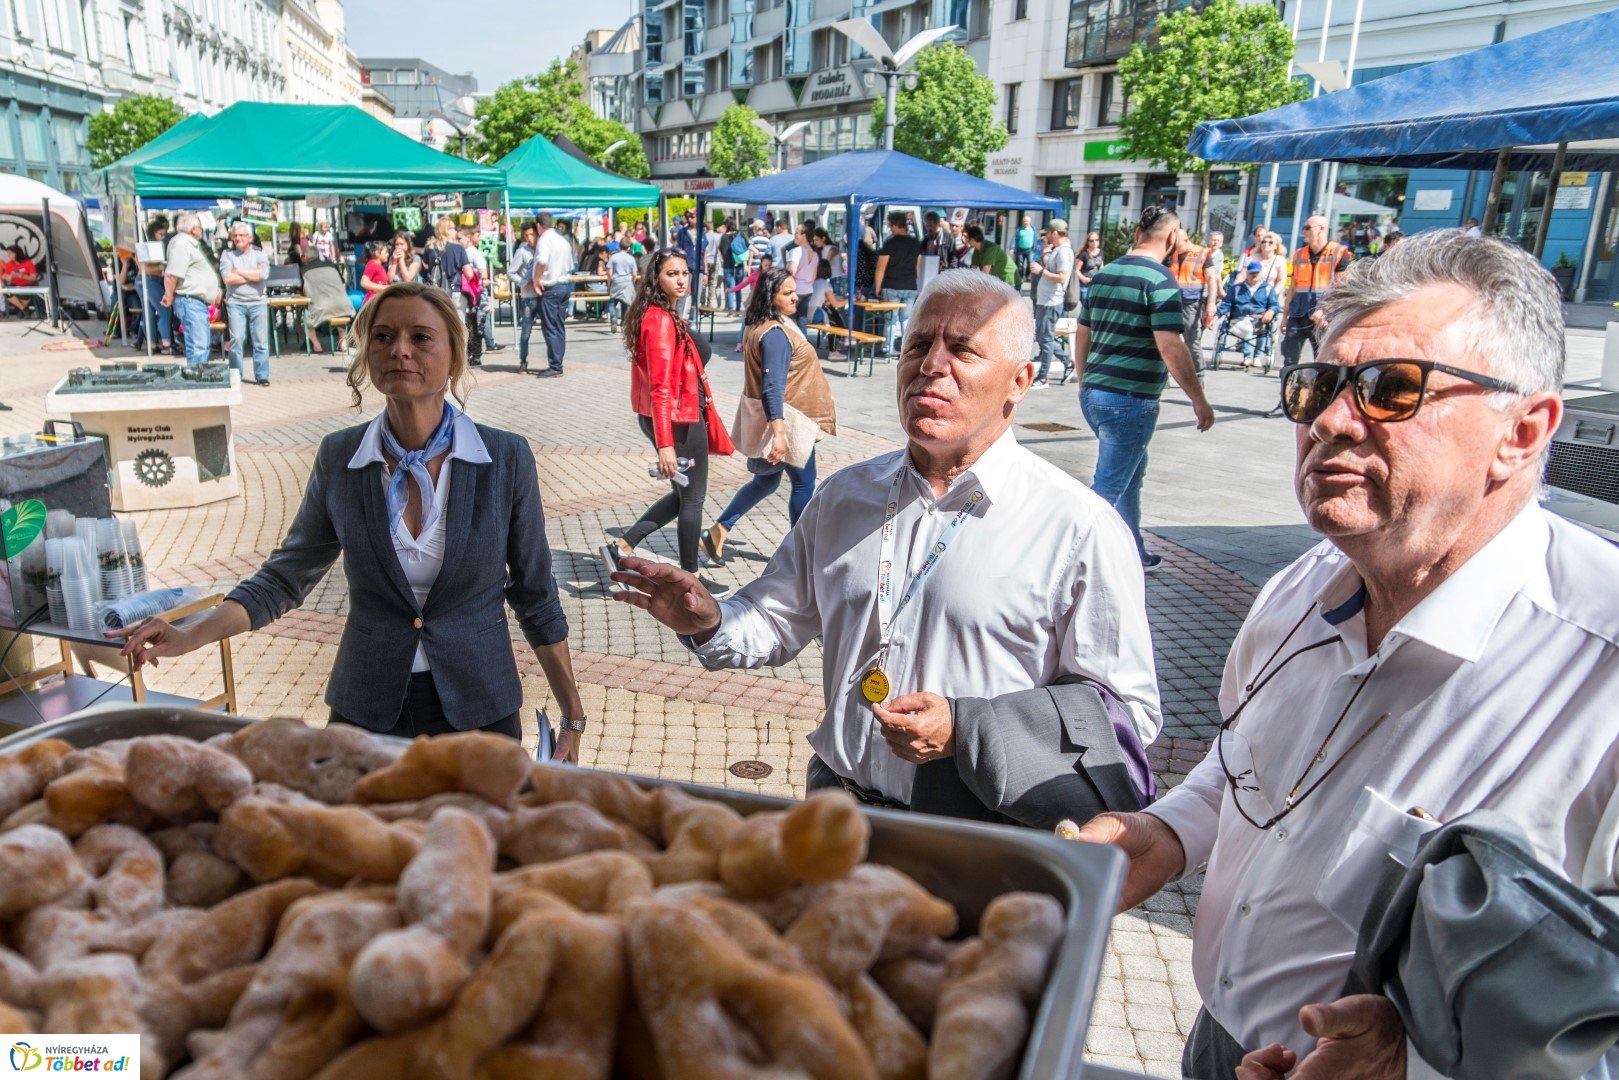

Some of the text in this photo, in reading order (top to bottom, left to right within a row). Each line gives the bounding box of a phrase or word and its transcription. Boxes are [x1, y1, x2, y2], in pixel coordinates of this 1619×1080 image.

[810, 82, 852, 102] IRODAHÁZ
[127, 424, 171, 434] Rotary Club
